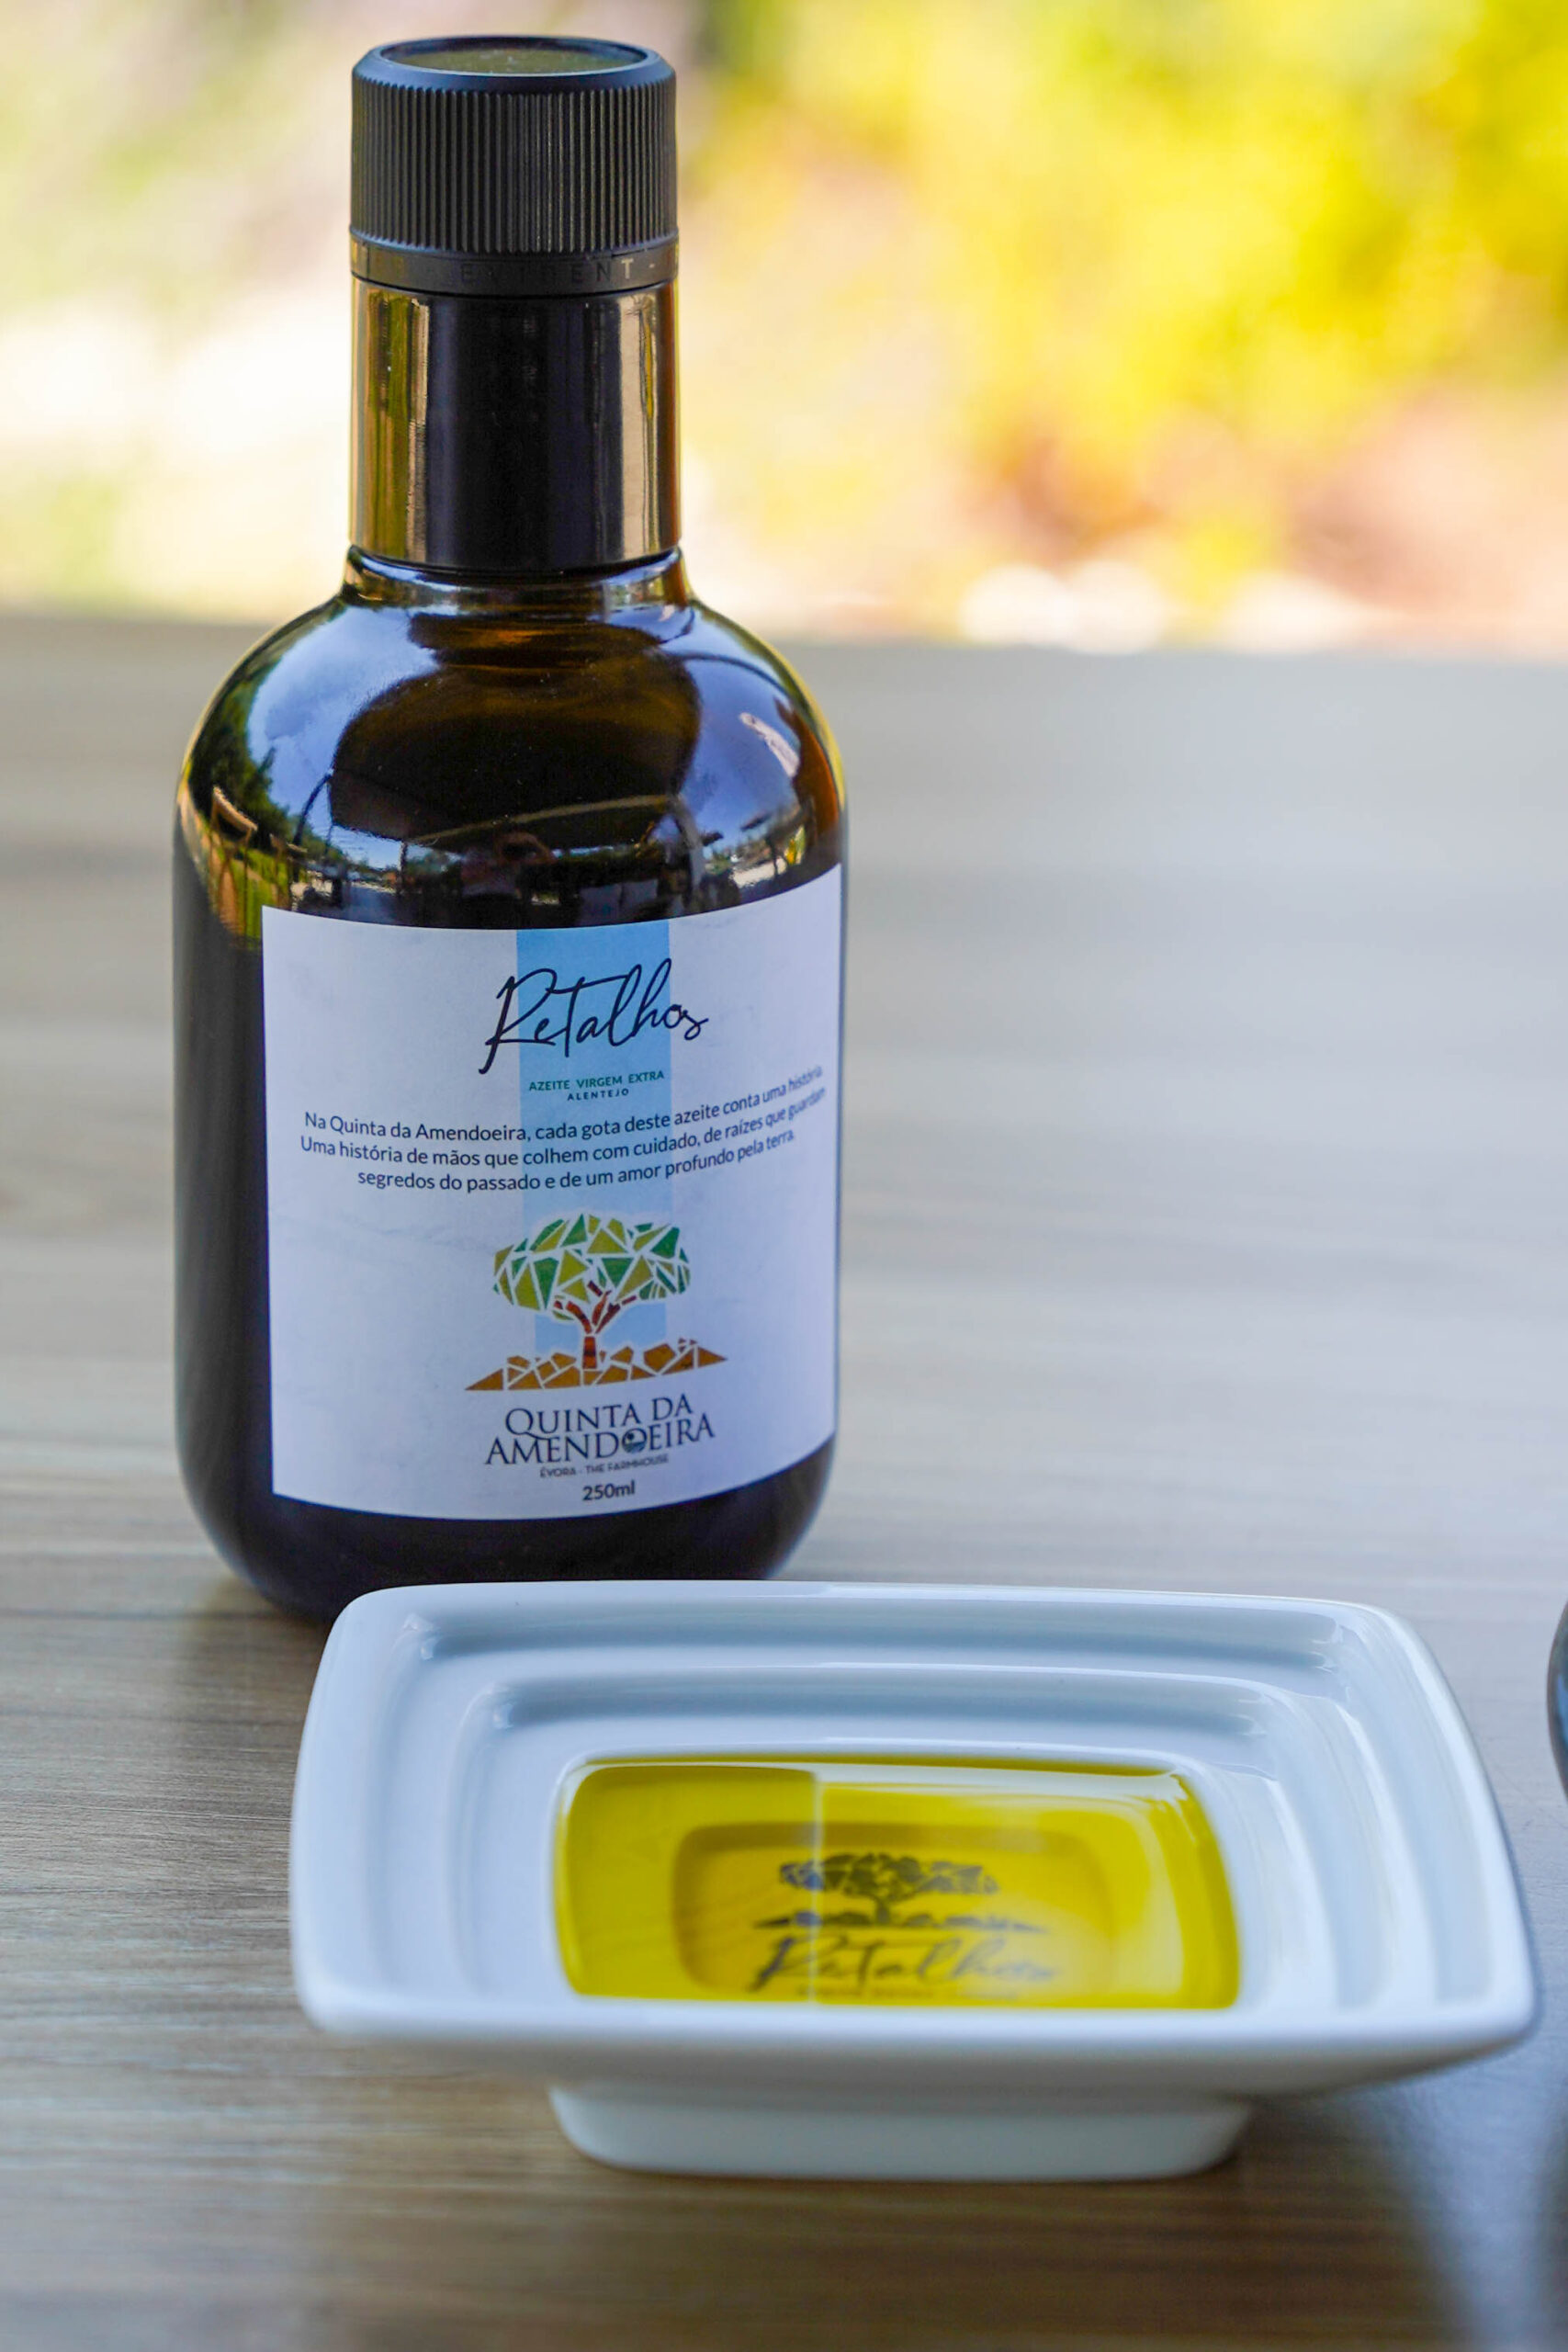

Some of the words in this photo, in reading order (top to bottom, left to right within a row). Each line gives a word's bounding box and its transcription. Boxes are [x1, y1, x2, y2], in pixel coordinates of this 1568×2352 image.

[479, 957, 709, 1074] Retalhos
[305, 1112, 326, 1129] Na
[330, 1115, 387, 1137] Quinta
[390, 1122, 412, 1138] da
[415, 1124, 532, 1142] Amendoeira,
[536, 1123, 578, 1140] cada
[581, 1120, 621, 1140] gota
[625, 1116, 671, 1133] deste
[674, 1104, 720, 1125] azeite
[723, 1093, 761, 1114] conta
[762, 1084, 787, 1102] uma
[788, 1066, 823, 1091] história
[529, 1080, 570, 1091] AZEITE
[577, 1074, 623, 1089] VIRGEM
[628, 1070, 665, 1084] EXTRA
[567, 1088, 629, 1102] ALENTEJO
[300, 1136, 336, 1156] Uma
[339, 1141, 402, 1162] história
[407, 1148, 428, 1164] de
[433, 1149, 480, 1166] mãos
[485, 1151, 519, 1169] que
[523, 1148, 589, 1165] colhem
[592, 1145, 630, 1160] com
[633, 1132, 701, 1157] cuidado,
[704, 1126, 722, 1144] de
[725, 1117, 763, 1139] raízes
[765, 1108, 786, 1128] que
[357, 1171, 435, 1189] segredos
[439, 1173, 462, 1190] do
[467, 1174, 540, 1193] passado
[545, 1176, 556, 1190] e
[559, 1171, 581, 1188] de
[586, 1170, 614, 1186] um
[618, 1165, 662, 1183] amor
[665, 1148, 735, 1179] profundo
[738, 1139, 764, 1163] pela
[484, 1412, 716, 1464] AMENDOEIRA
[505, 1402, 641, 1440] QUINTA
[651, 1393, 694, 1421] DA
[539, 1466, 577, 1478] ÉVORA
[586, 1464, 604, 1475] THE
[607, 1453, 670, 1472] FARMHOUSE
[581, 1479, 636, 1501] 250ml
